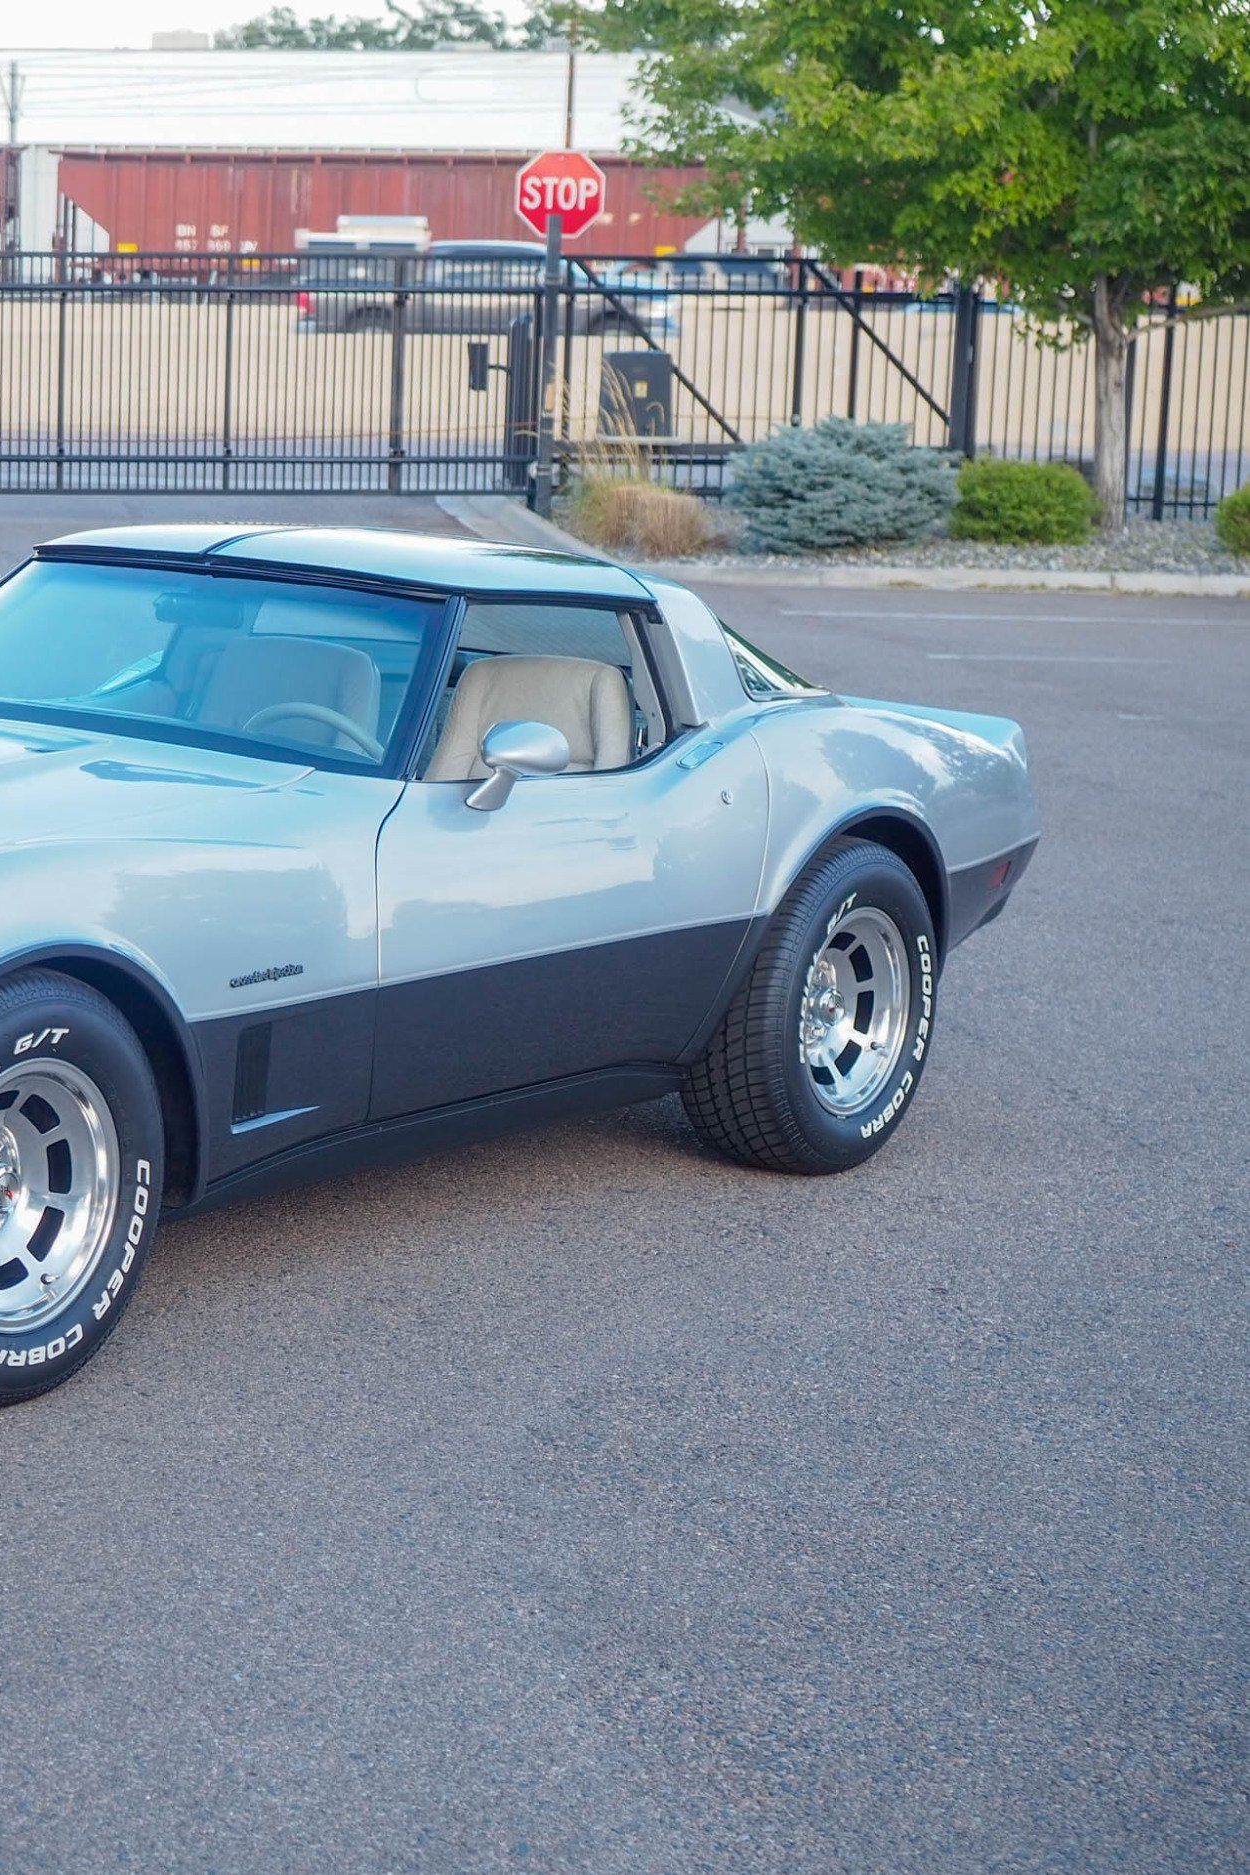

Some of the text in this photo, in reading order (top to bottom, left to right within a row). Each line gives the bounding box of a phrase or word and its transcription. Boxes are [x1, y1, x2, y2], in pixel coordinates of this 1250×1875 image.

[522, 176, 598, 211] STOP
[13, 1028, 69, 1055] G/T
[860, 935, 933, 1138] COOPER COBRA
[92, 1159, 150, 1320] COOPER
